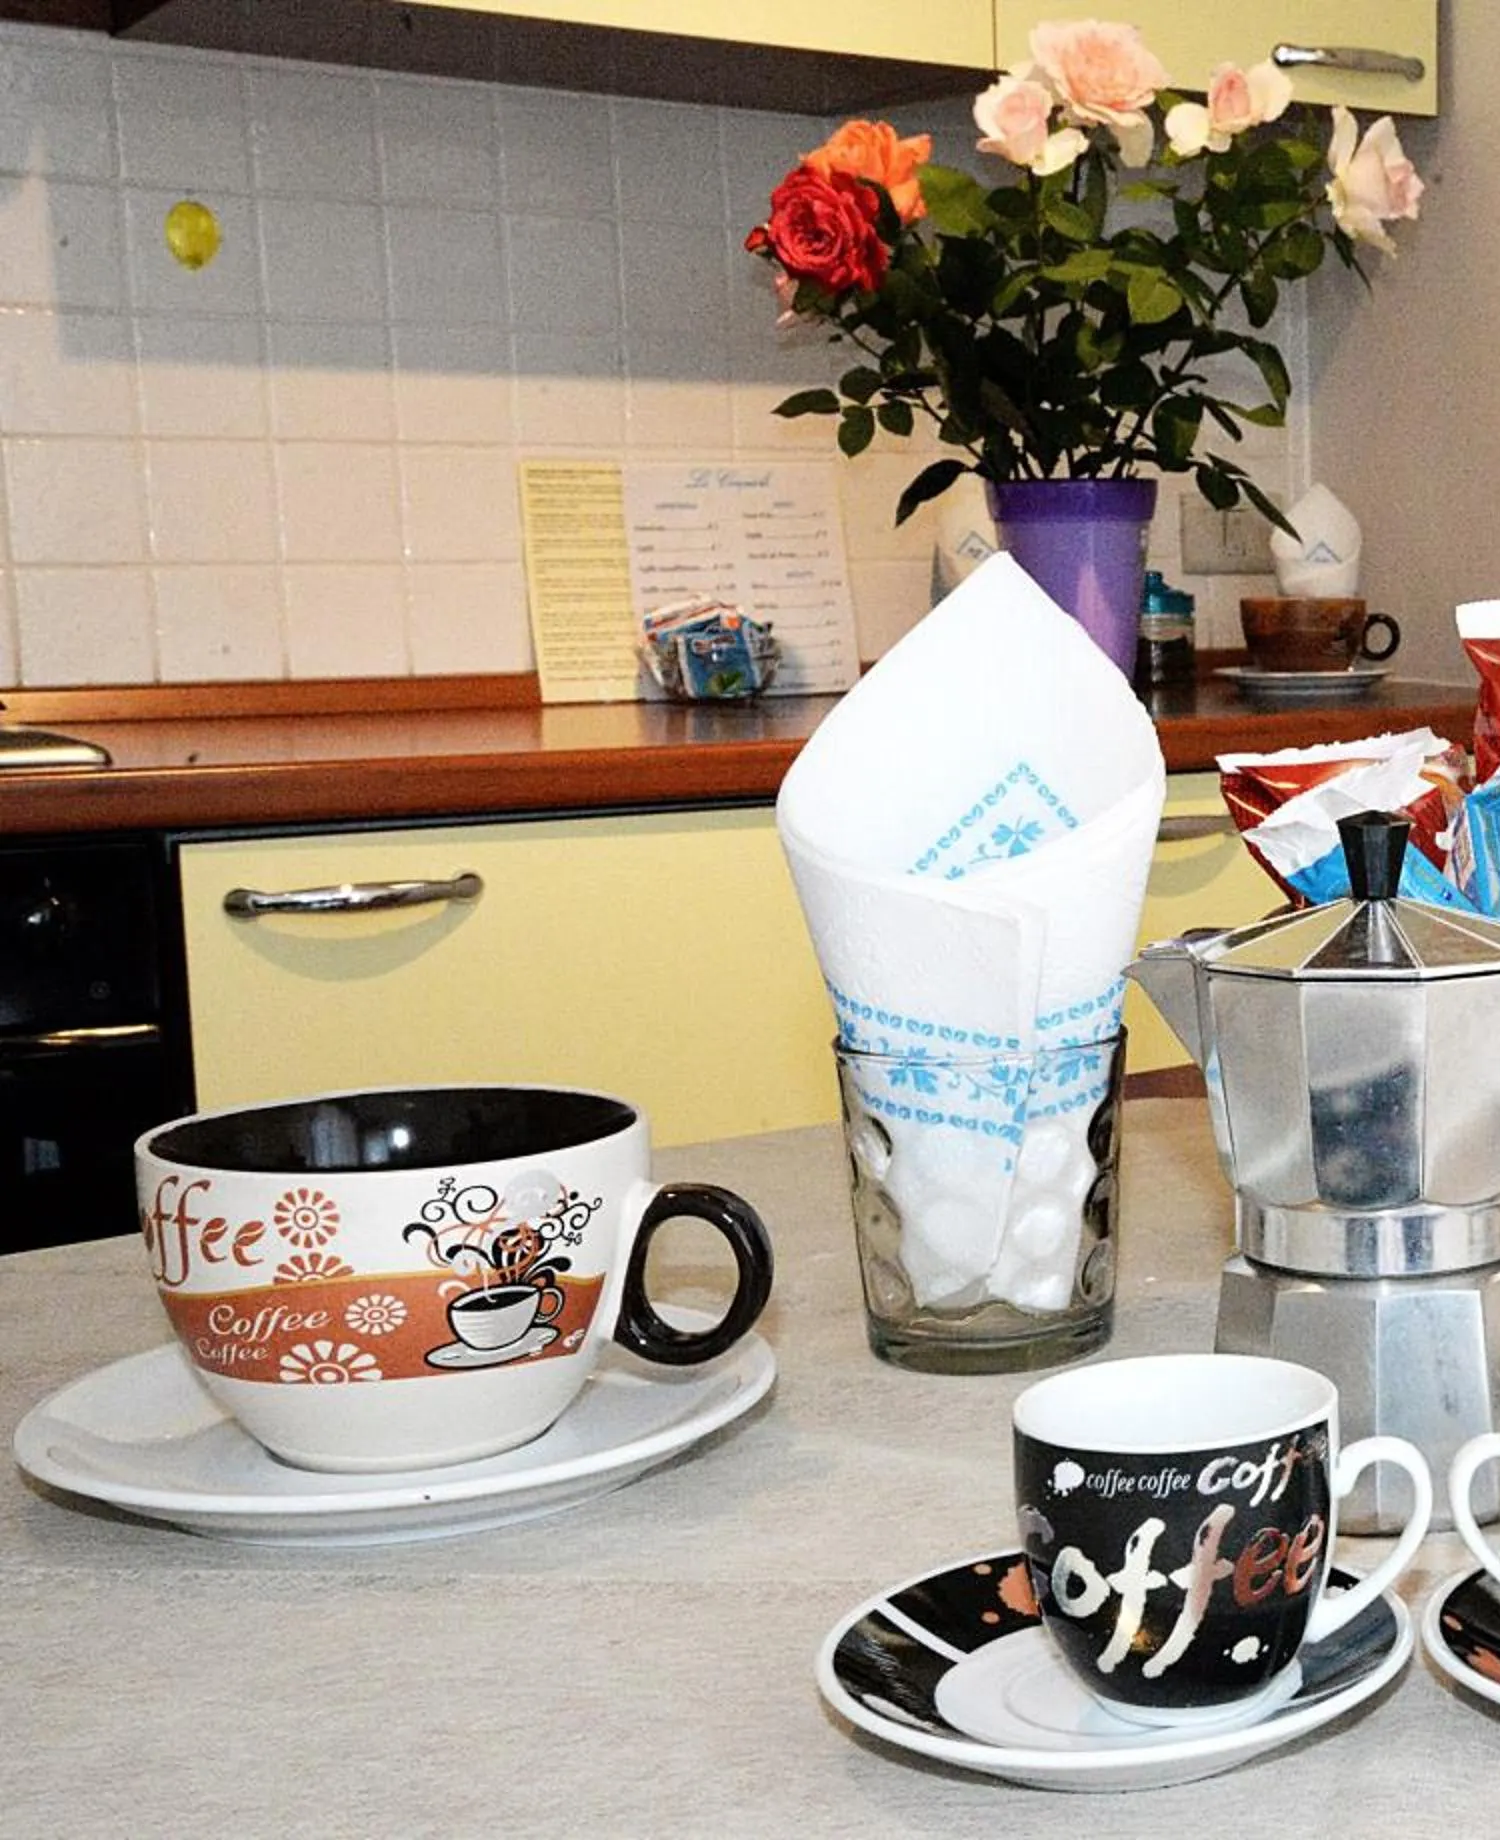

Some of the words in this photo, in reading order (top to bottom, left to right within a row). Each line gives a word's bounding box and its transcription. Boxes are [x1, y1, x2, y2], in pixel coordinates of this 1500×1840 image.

[140, 1174, 268, 1287] offee
[207, 1304, 329, 1340] Coffee
[196, 1338, 269, 1363] Coffee
[1085, 1468, 1136, 1500] coffee
[1137, 1464, 1192, 1499] coffee
